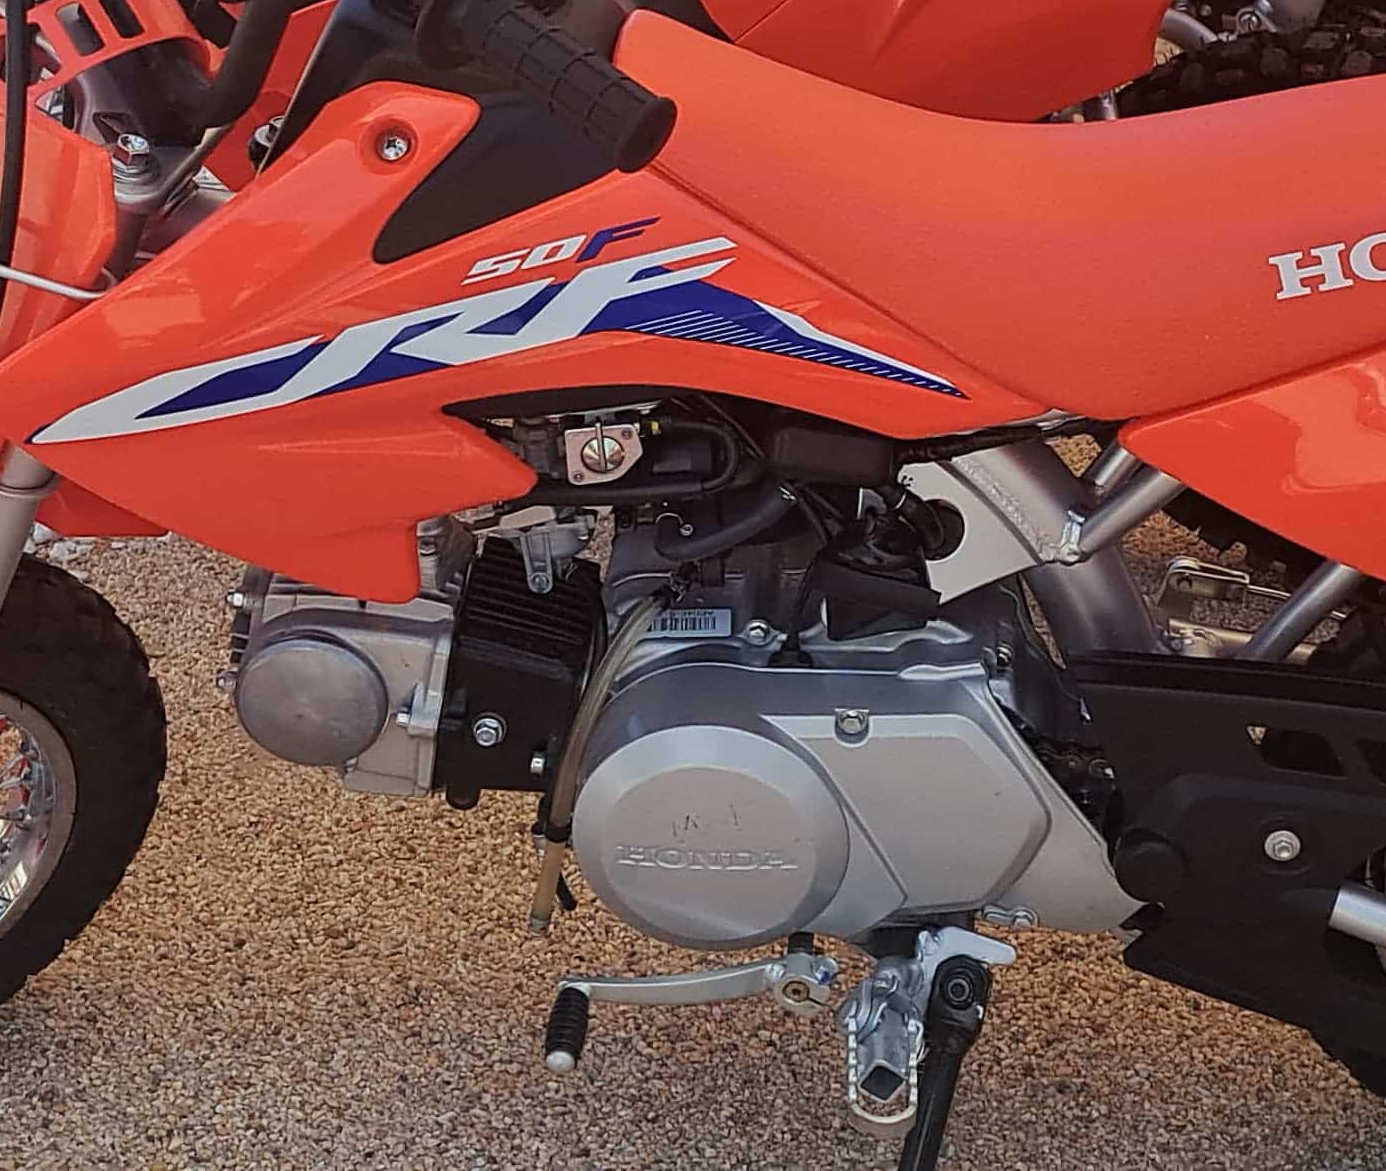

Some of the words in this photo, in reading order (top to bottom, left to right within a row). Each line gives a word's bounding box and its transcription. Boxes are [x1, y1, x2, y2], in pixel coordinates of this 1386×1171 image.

[461, 216, 662, 286] 50F
[30, 236, 739, 445] CRF
[615, 845, 799, 872] HONDA
